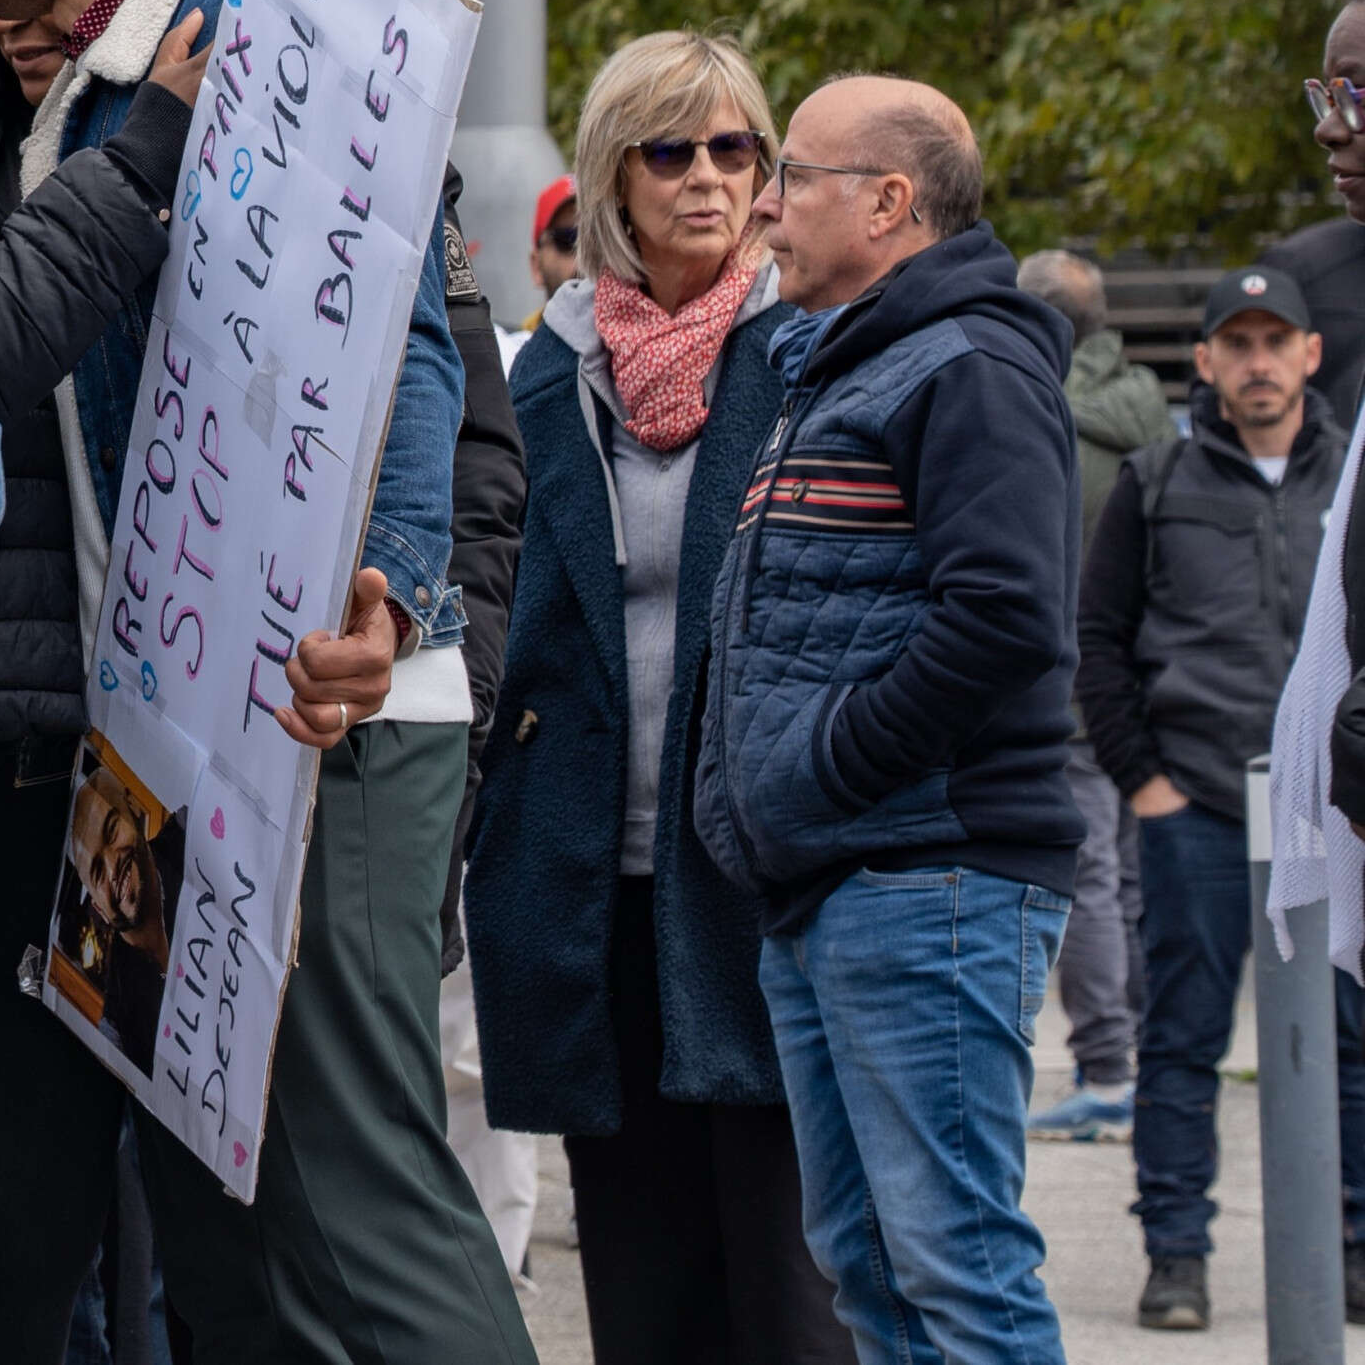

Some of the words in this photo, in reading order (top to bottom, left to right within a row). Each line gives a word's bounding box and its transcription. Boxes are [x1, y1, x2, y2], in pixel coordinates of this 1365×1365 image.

[222, 310, 261, 366] À
[235, 202, 280, 291] LA
[243, 549, 304, 734] TUÉ
[283, 375, 330, 504] PAR
[314, 13, 410, 350] BALLES
[113, 327, 192, 659] REPOSE
[187, 216, 210, 302] EN
[159, 404, 230, 681] STOP
[165, 856, 217, 1097] LILIAN
[200, 860, 256, 1138] DEJEAN
